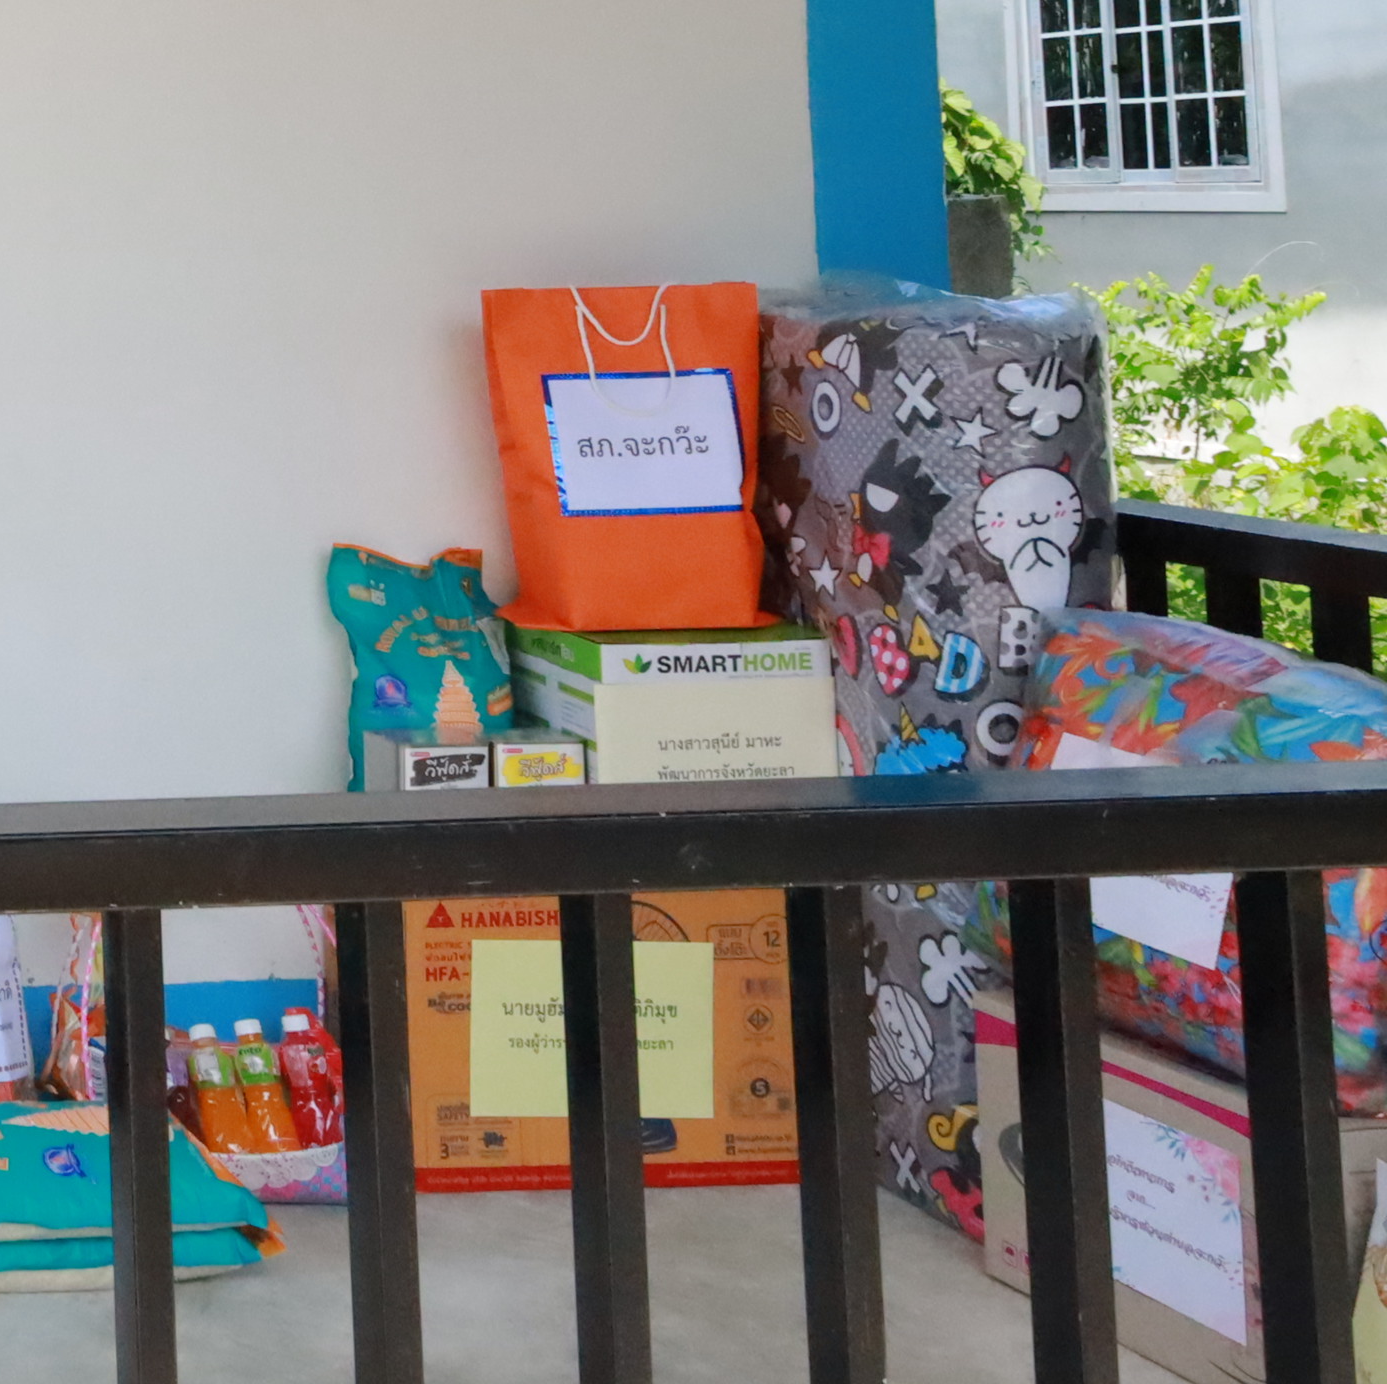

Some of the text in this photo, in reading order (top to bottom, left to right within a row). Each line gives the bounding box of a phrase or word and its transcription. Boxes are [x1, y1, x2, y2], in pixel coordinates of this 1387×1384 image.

[577, 425, 709, 458] สภ.จะกว๊ะ
[657, 652, 813, 674] SMARTHOME
[657, 733, 783, 754] นางสาวสุนีย์ มาหะ
[657, 763, 795, 781] พัฒนาการจังหวัดยะลา
[460, 909, 560, 929] HANABISH
[763, 929, 781, 947] 12
